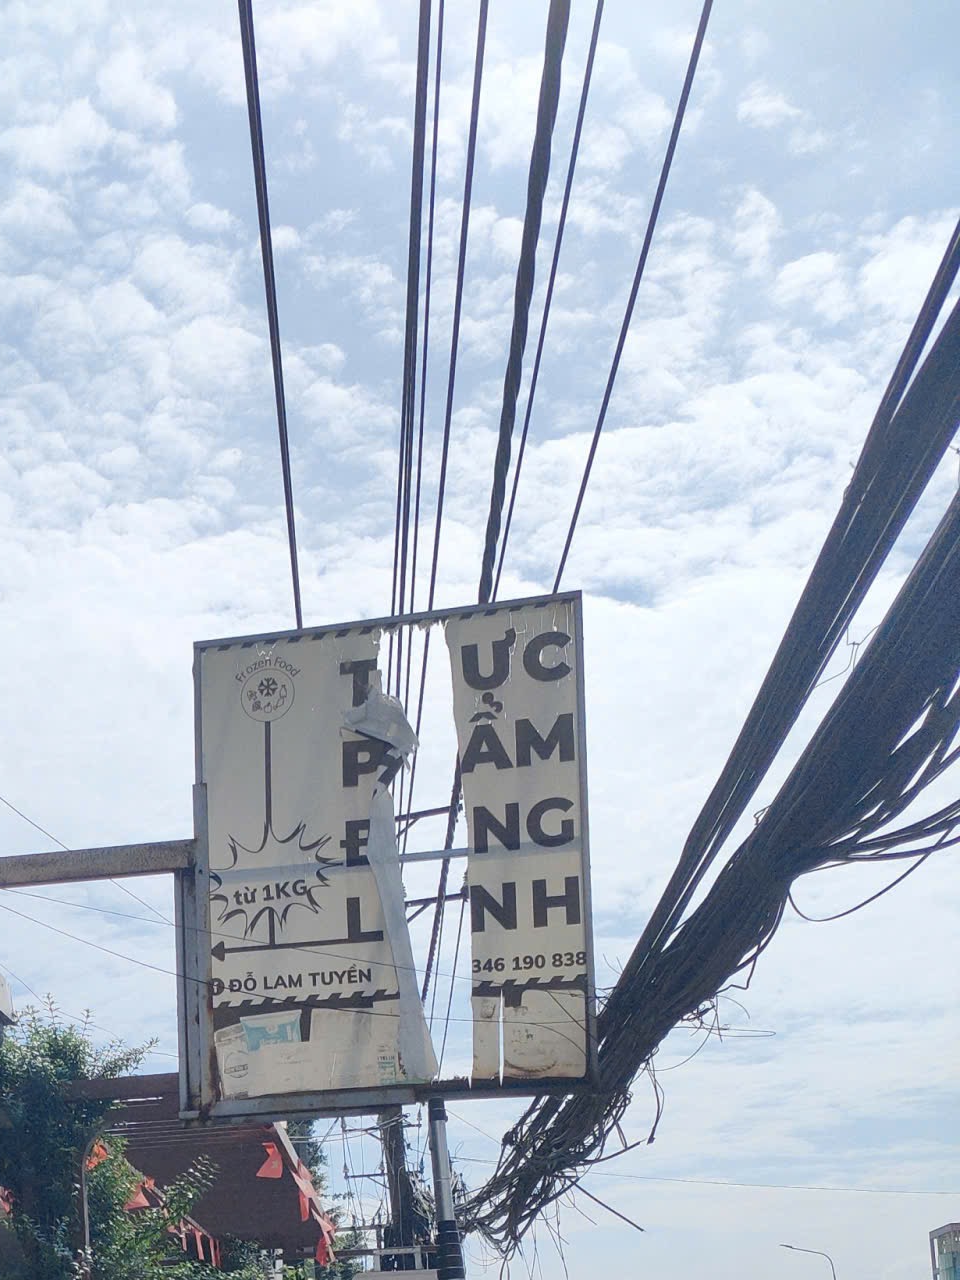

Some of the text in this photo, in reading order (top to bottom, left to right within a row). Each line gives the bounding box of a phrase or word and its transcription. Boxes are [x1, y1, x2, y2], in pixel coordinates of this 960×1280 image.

[274, 656, 301, 677] Food
[233, 879, 307, 905] từ 1KG
[512, 955, 545, 971] 190
[552, 952, 586, 967] 838
[229, 963, 372, 992] ĐỖ LAM TUYỀN
